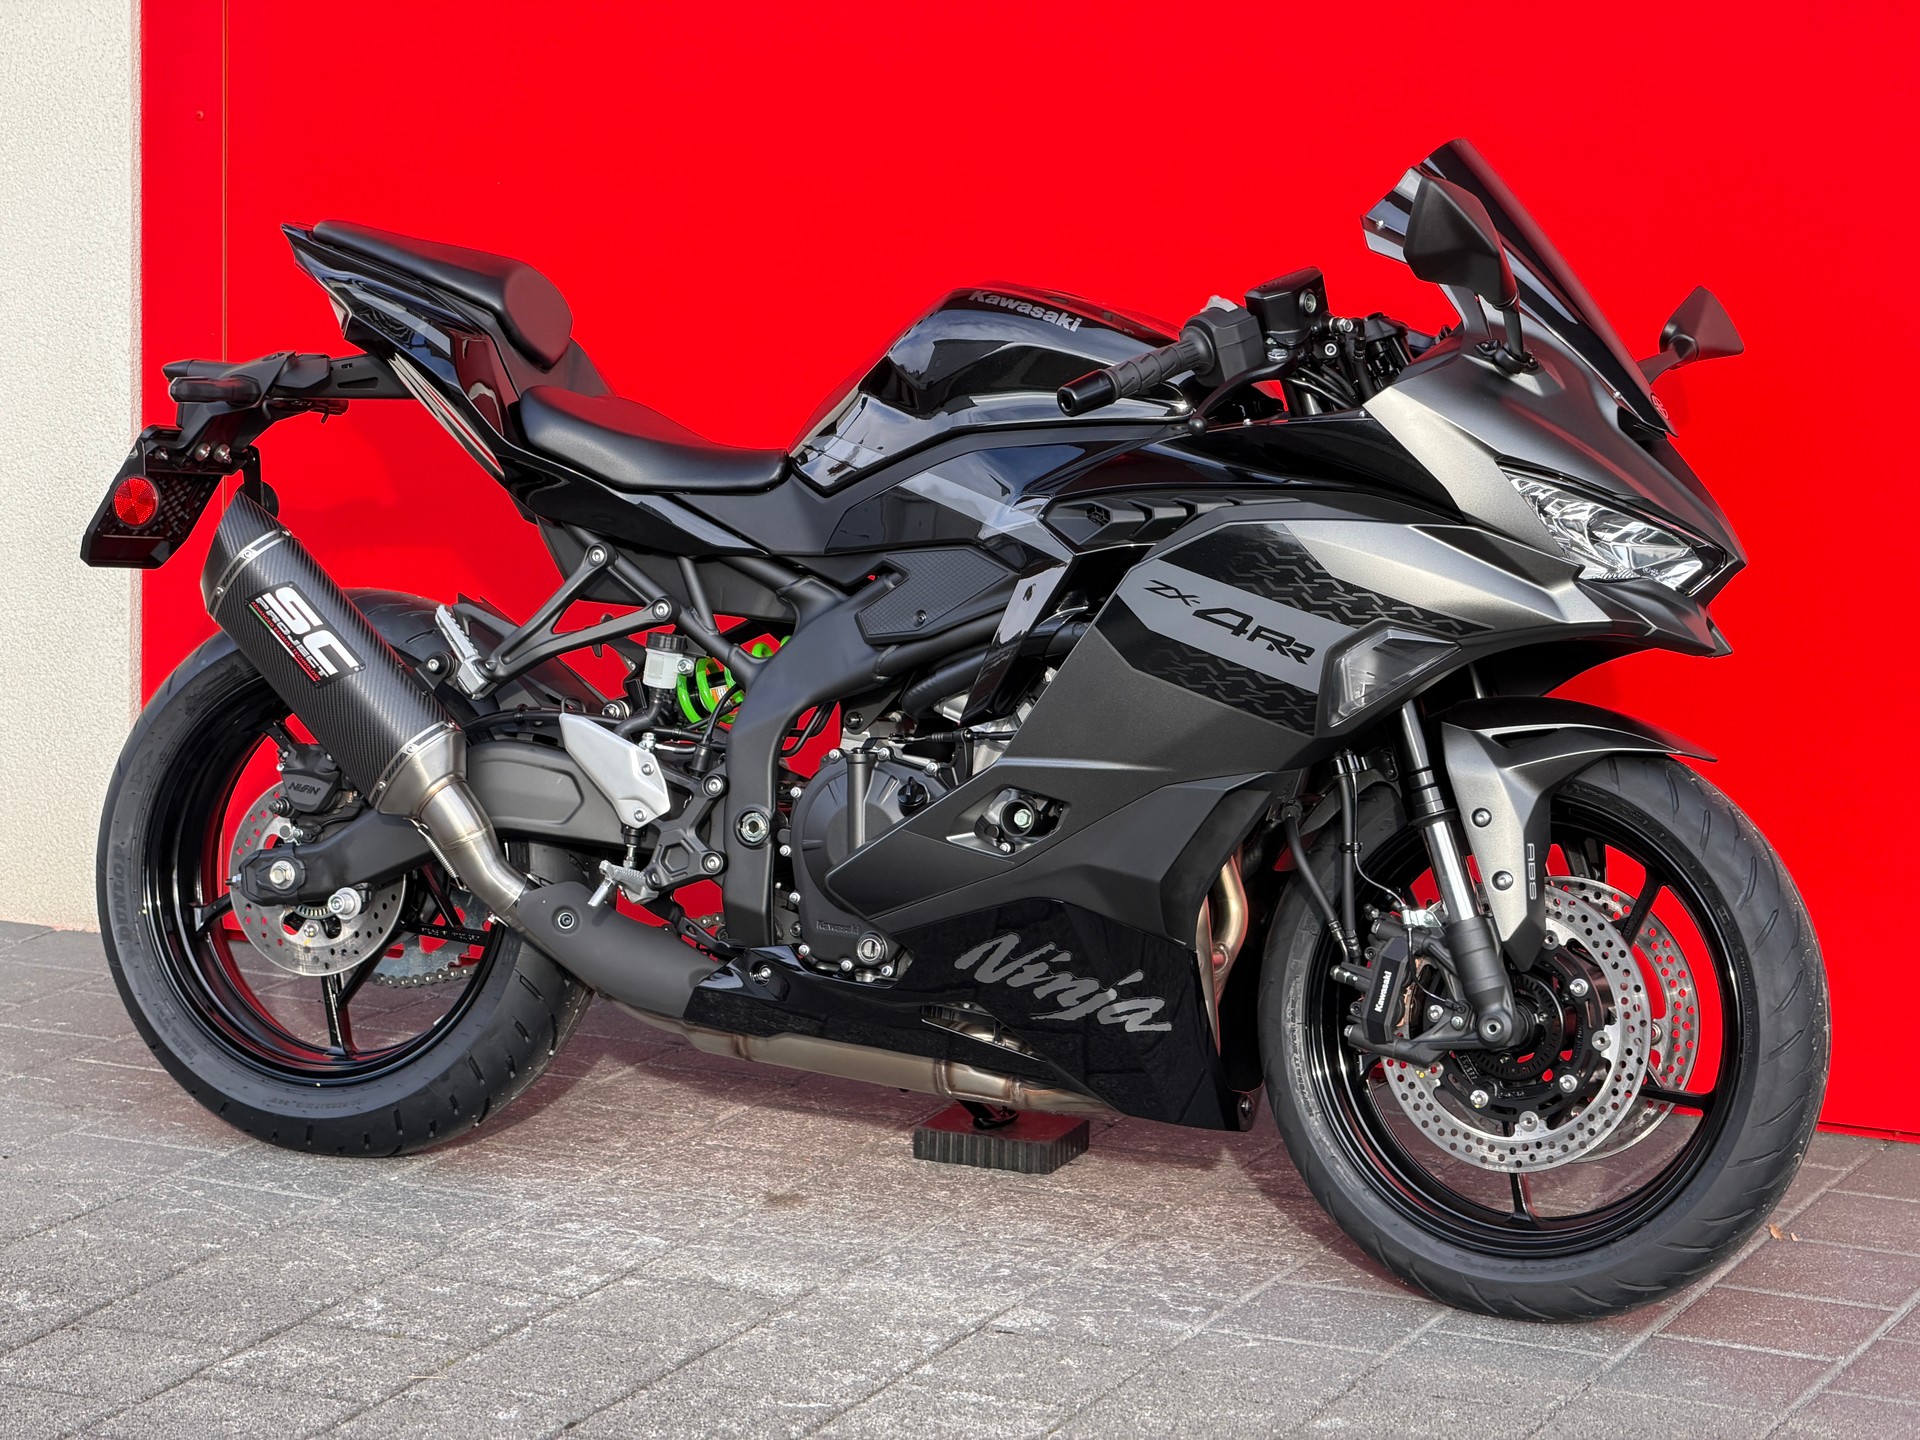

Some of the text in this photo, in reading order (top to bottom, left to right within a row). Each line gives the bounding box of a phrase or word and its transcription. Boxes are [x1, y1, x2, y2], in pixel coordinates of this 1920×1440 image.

[968, 290, 1083, 333] Kawasaki
[251, 601, 322, 681] ADVANCED EXHAUST TECHNOLOGY
[255, 597, 329, 678] PROJECT
[262, 586, 360, 676] SC
[288, 781, 321, 795] NISSIN
[1526, 842, 1537, 900] ABS
[816, 920, 860, 935] Kawasaki
[953, 931, 1173, 1033] Ninja
[1374, 970, 1393, 1013] Kawasaki
